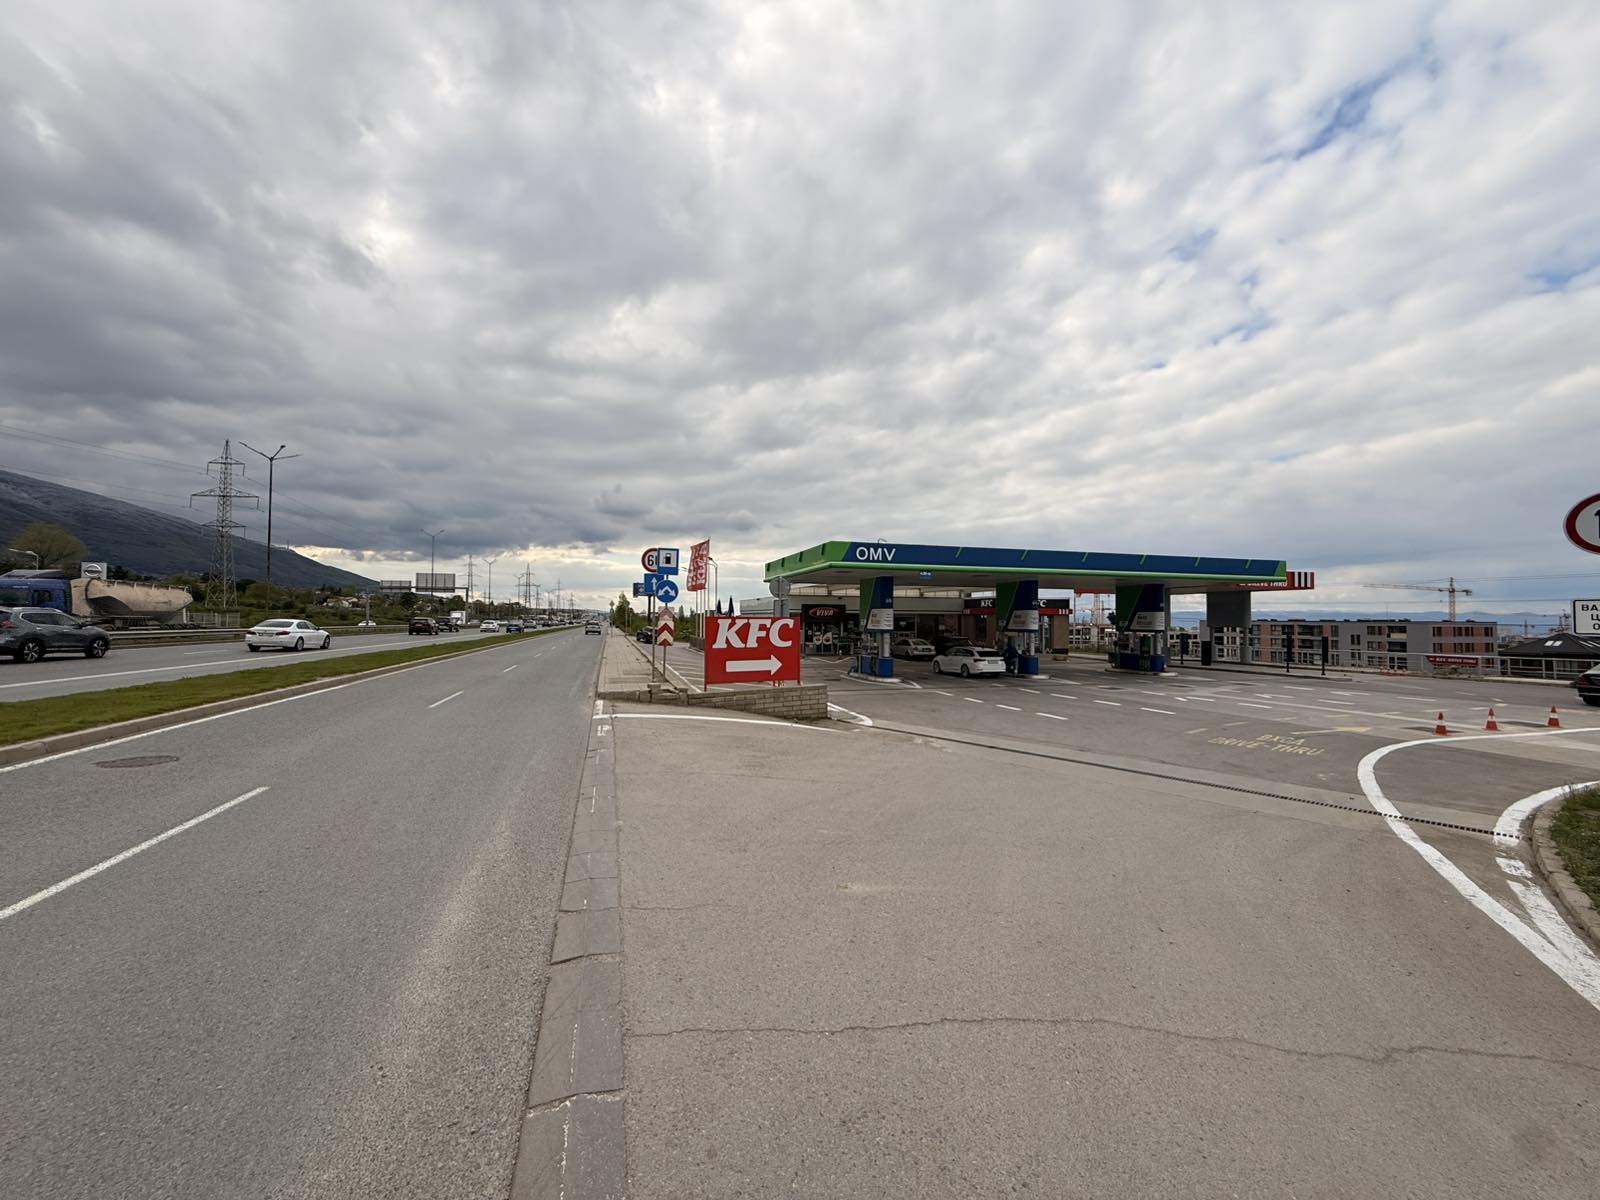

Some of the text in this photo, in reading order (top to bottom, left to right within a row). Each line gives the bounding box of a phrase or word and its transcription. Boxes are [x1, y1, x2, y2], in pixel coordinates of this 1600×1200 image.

[647, 554, 657, 567] 6
[855, 546, 896, 562] OMV
[980, 599, 994, 608] KFC
[815, 609, 834, 617] VIVA
[712, 618, 794, 649] KFC
